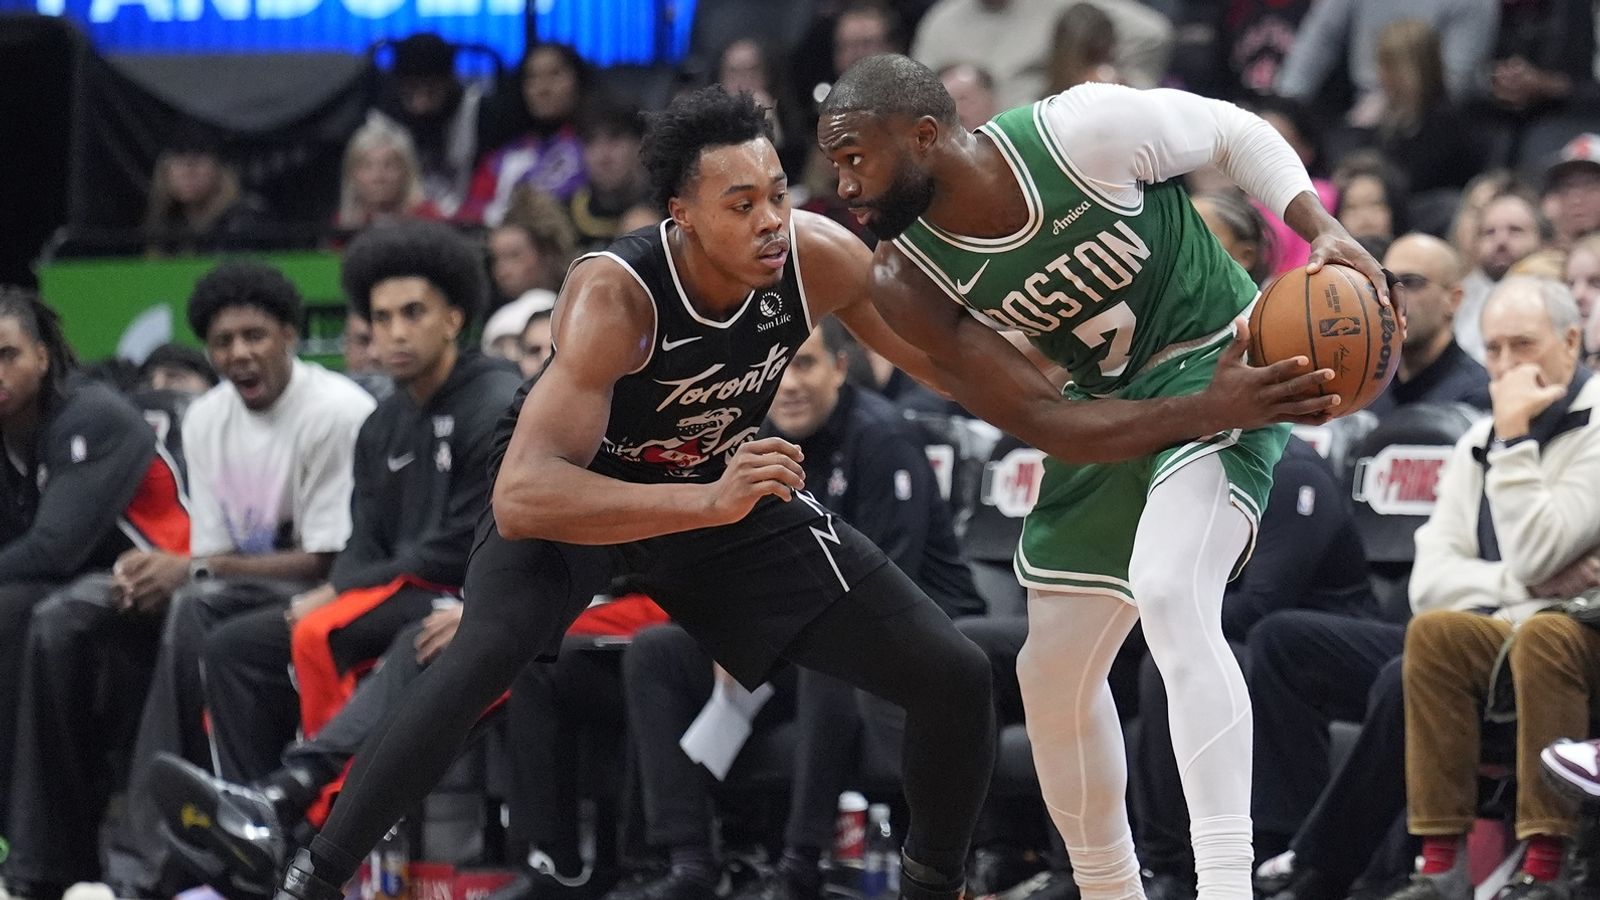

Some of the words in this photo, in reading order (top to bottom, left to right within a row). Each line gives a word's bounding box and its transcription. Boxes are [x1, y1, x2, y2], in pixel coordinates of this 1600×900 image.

[1053, 201, 1091, 235] Amica
[757, 322, 775, 333] Sun
[775, 313, 791, 326] Life
[1072, 301, 1137, 376] 7
[653, 343, 789, 412] Toronto
